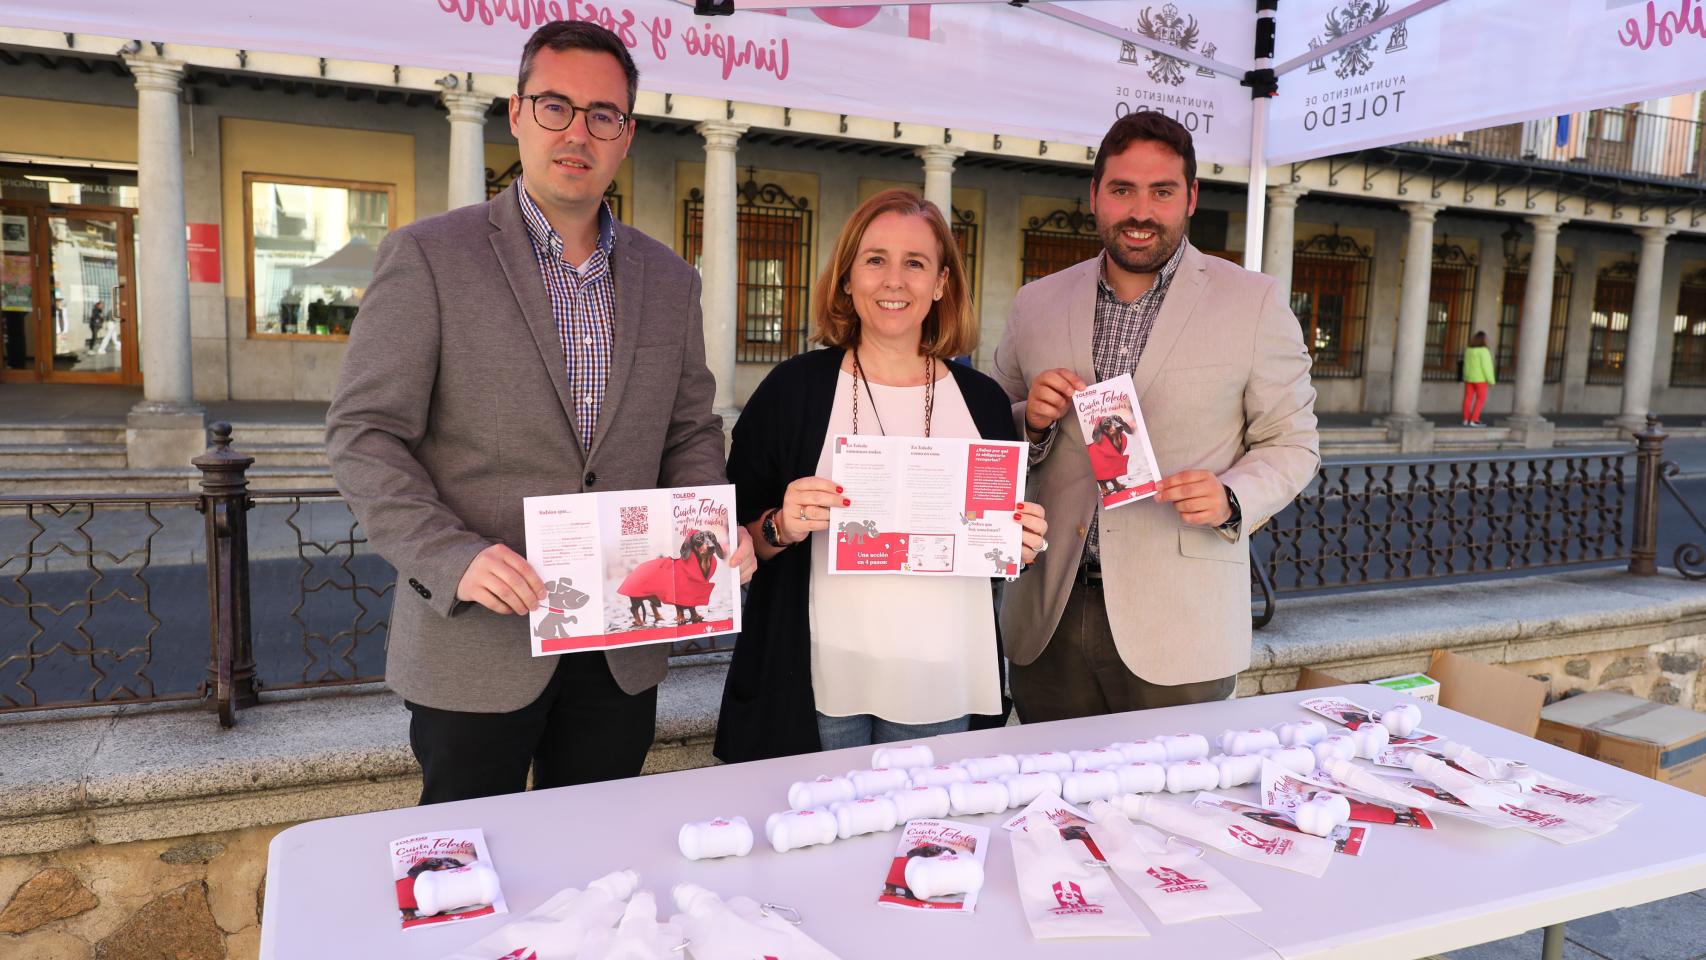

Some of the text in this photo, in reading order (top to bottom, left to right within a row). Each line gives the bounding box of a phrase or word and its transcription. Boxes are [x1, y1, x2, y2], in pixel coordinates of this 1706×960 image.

[1100, 390, 1128, 405] Toledo
[673, 492, 696, 500] TOLEDO
[674, 498, 728, 518] Cuida Toledo
[940, 826, 977, 842] Toledo
[432, 837, 474, 850] Toledo
[1163, 883, 1209, 894] TOLEDO
